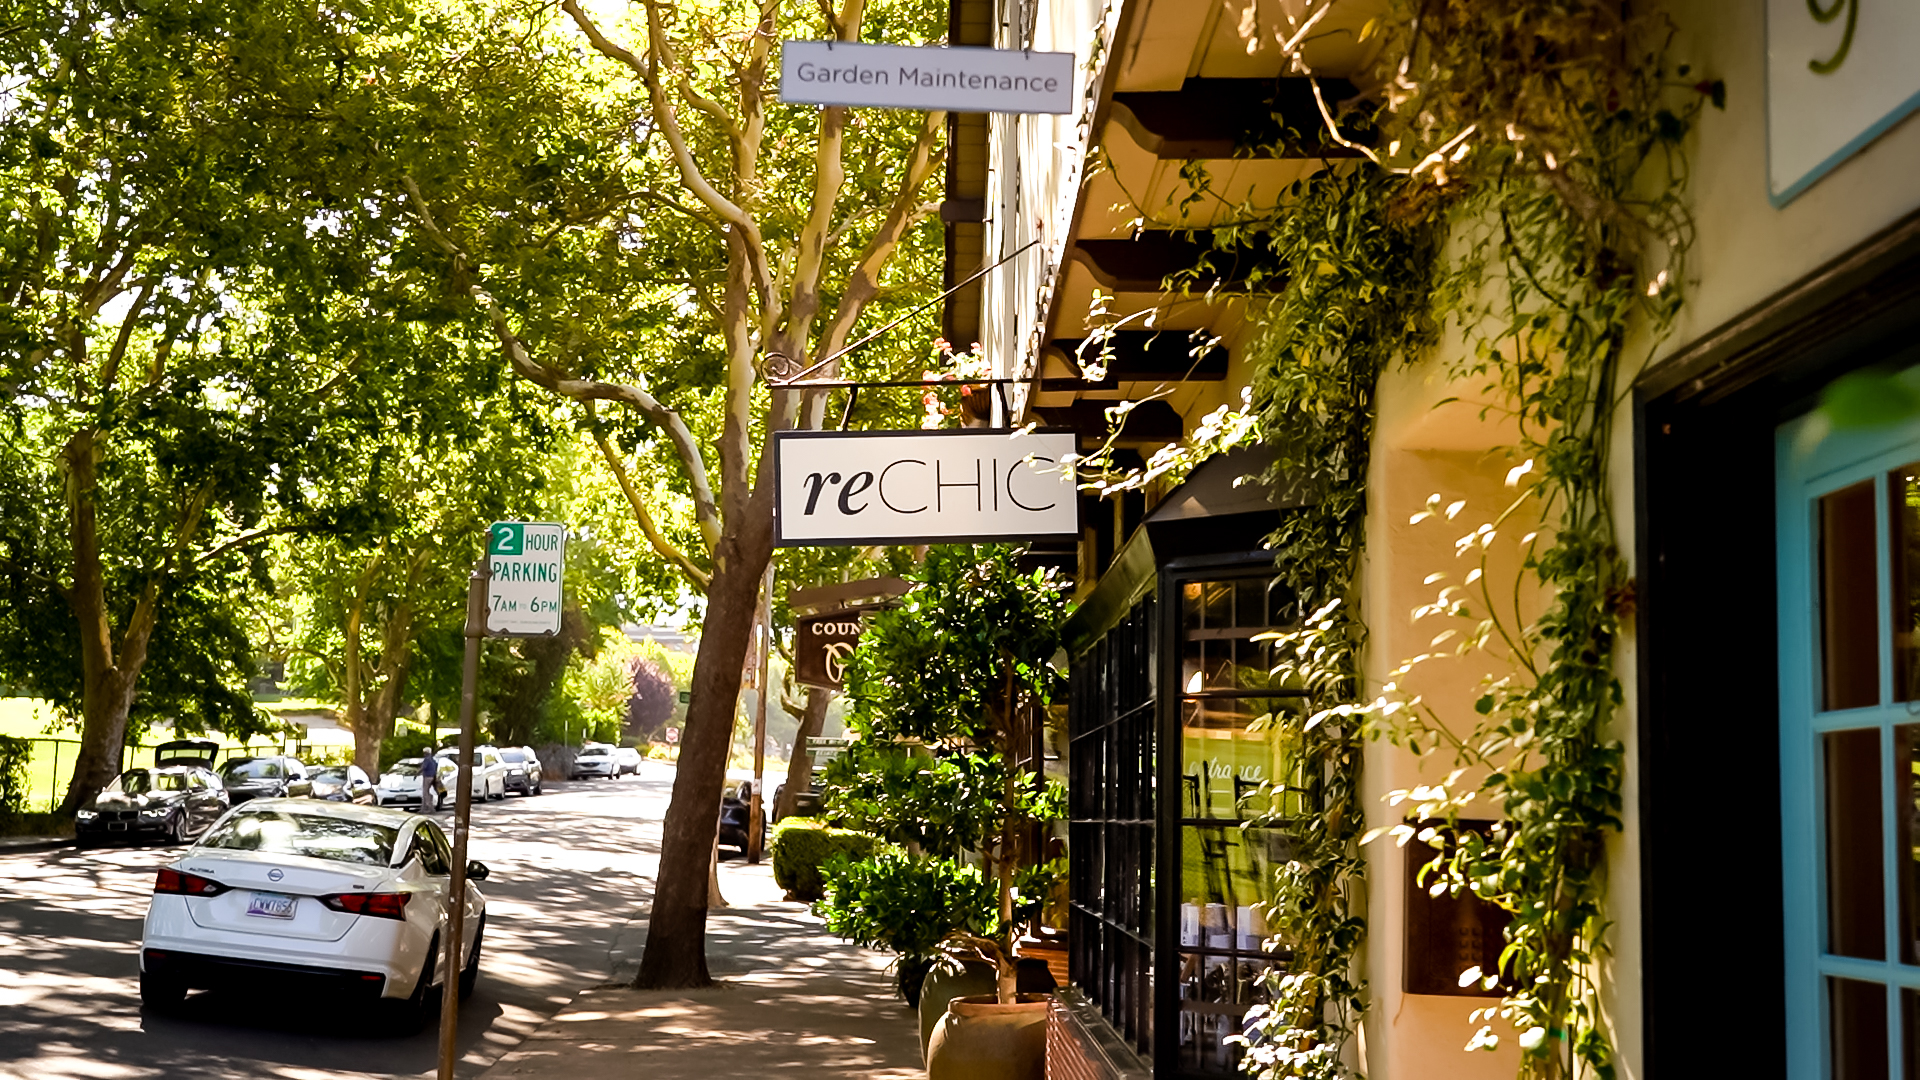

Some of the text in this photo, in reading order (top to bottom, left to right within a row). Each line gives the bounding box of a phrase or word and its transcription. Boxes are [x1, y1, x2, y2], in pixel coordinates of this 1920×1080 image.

[797, 61, 1058, 93] Garden Maintenance
[803, 457, 1056, 515] reCHIC
[497, 526, 558, 551] 2 HOUR
[493, 562, 557, 583] PARKING
[493, 595, 517, 612] 7AM
[530, 596, 557, 613] 6PM
